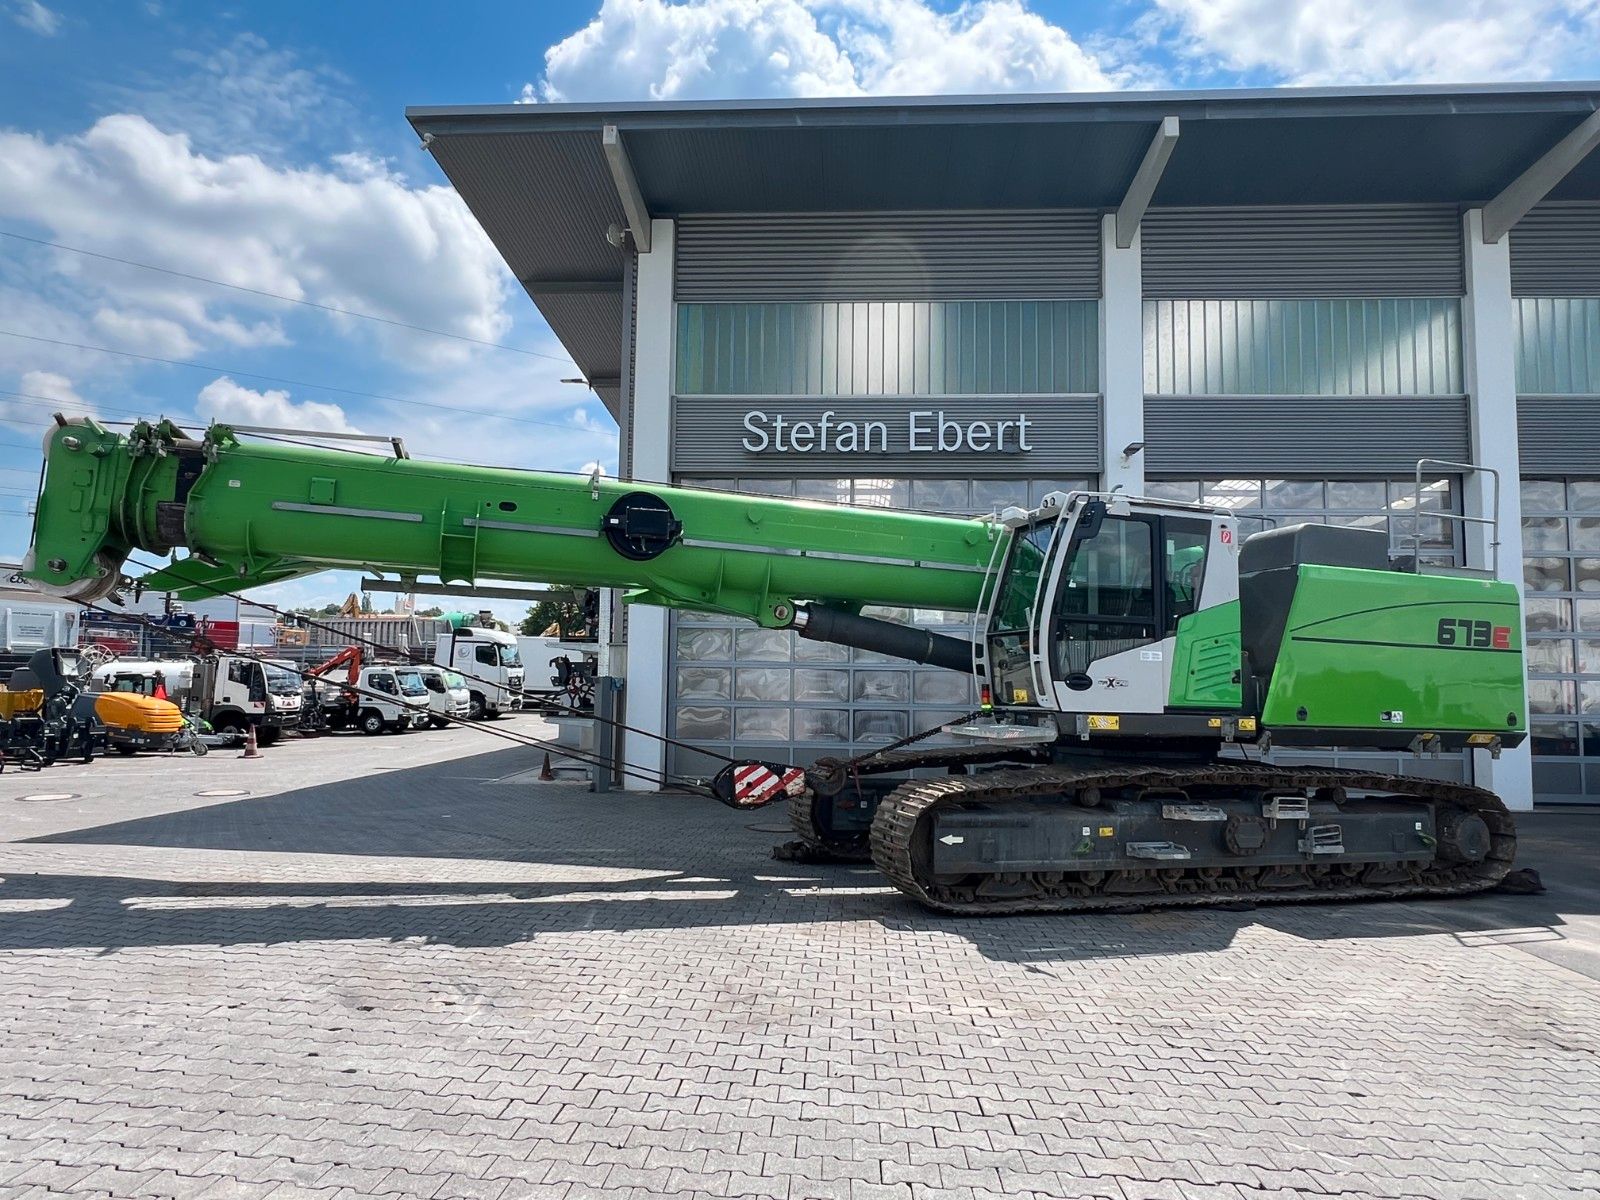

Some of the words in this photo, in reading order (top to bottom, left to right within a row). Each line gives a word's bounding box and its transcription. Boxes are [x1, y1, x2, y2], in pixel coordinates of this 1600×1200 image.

[742, 411, 887, 451] Stefan
[909, 411, 1032, 451] Ebert
[1437, 617, 1511, 649] 673E
